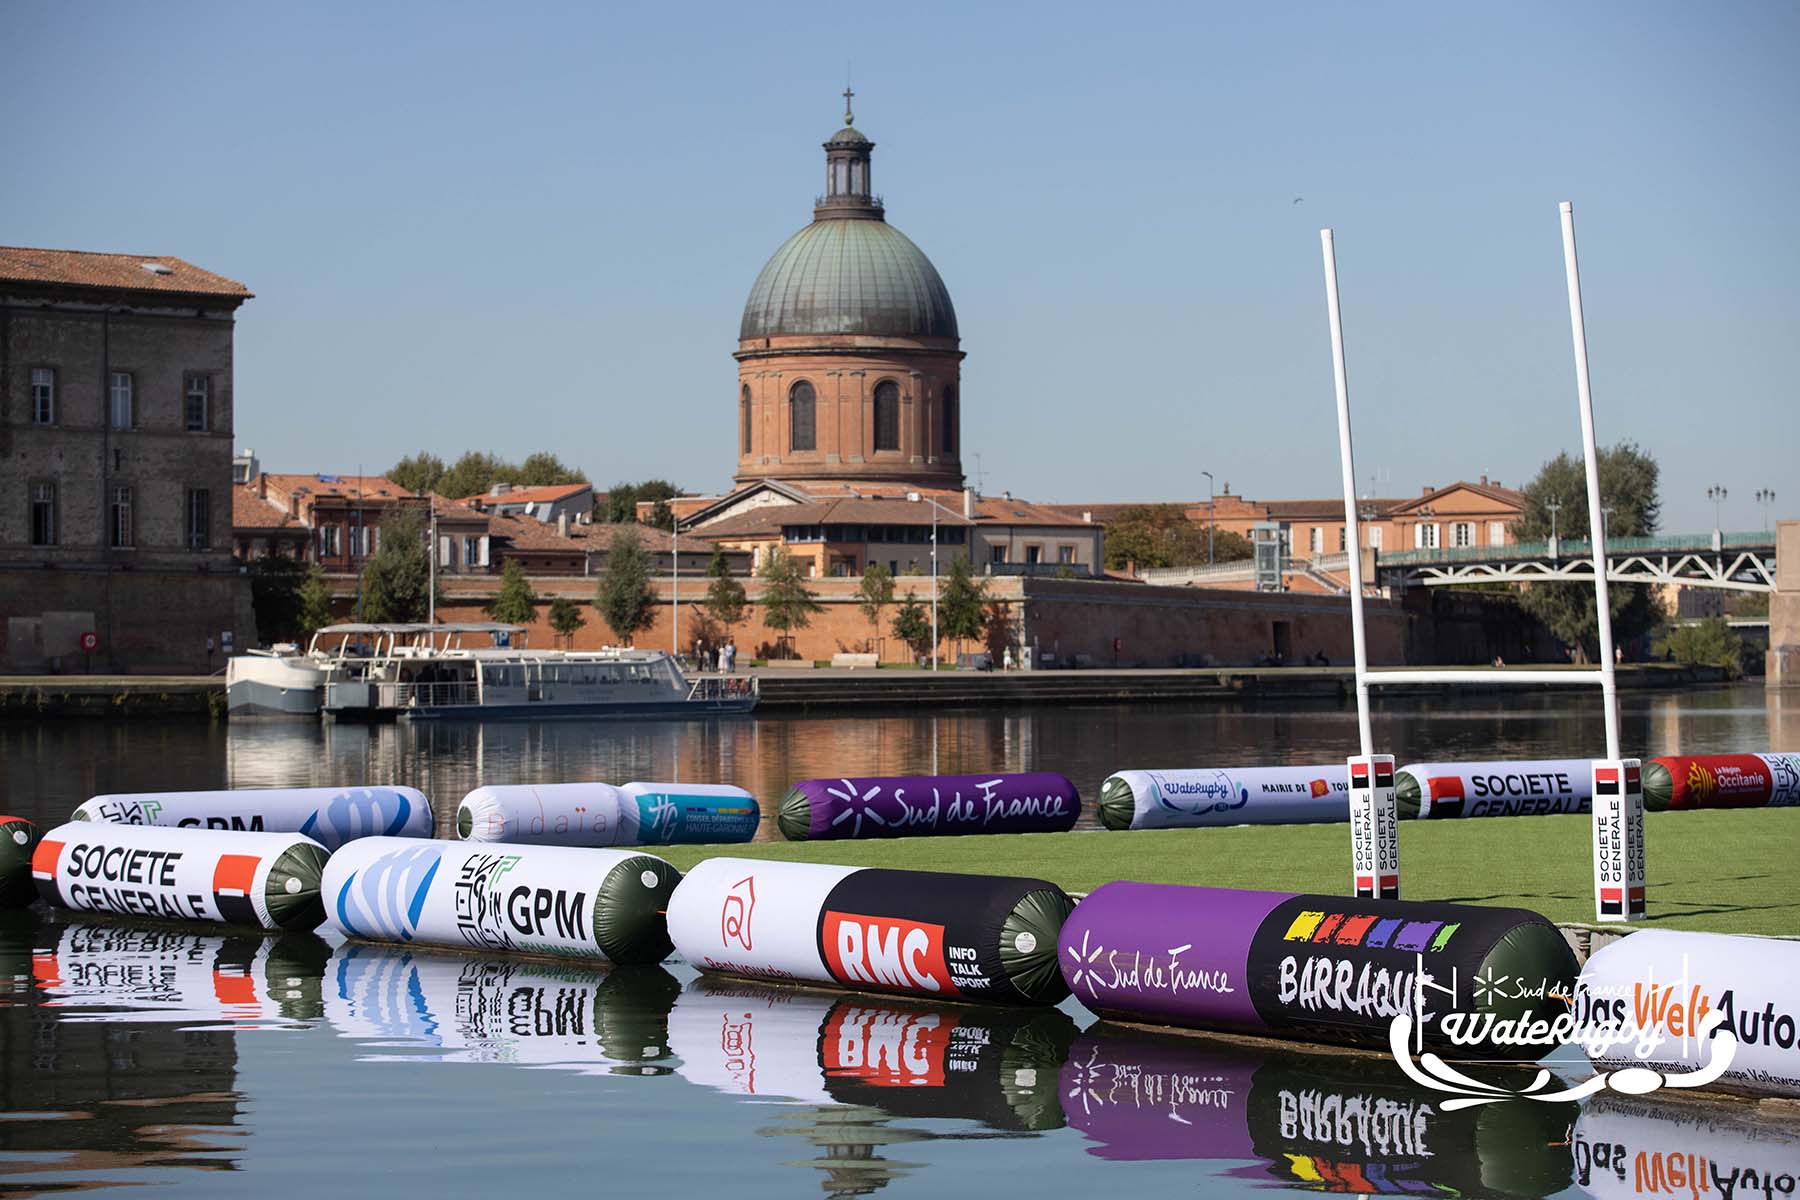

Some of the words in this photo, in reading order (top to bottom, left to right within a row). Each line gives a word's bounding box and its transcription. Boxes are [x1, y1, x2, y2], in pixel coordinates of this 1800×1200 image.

[889, 788, 940, 829] Sud
[946, 792, 979, 822] de
[975, 779, 1069, 826] France
[1262, 783, 1294, 793] MAIRIE
[1295, 783, 1307, 793] DE
[1471, 774, 1573, 796] SOCIETE
[1718, 772, 1764, 787] Occitanie
[1354, 809, 1364, 871] SOCIETE
[1363, 793, 1373, 871] GENERALE
[1378, 808, 1387, 871] SOCIETE
[1387, 792, 1398, 870] GENERALE
[1598, 816, 1610, 882] SOCIETE
[1610, 801, 1622, 882] GENERALE
[1627, 815, 1636, 882] SOCIETE
[1635, 799, 1644, 881] GENERALE
[67, 844, 184, 886] SOCIETE
[508, 885, 587, 941] GPM
[838, 920, 940, 992] RMC
[949, 946, 977, 961] INFO
[950, 963, 983, 976] TALK
[1107, 949, 1142, 992] Sud
[1144, 956, 1168, 988] de
[1168, 943, 1235, 995] France
[951, 976, 991, 988] SPORT
[1278, 955, 1437, 1023] BARRAQUE
[1575, 984, 1626, 1031] Das
